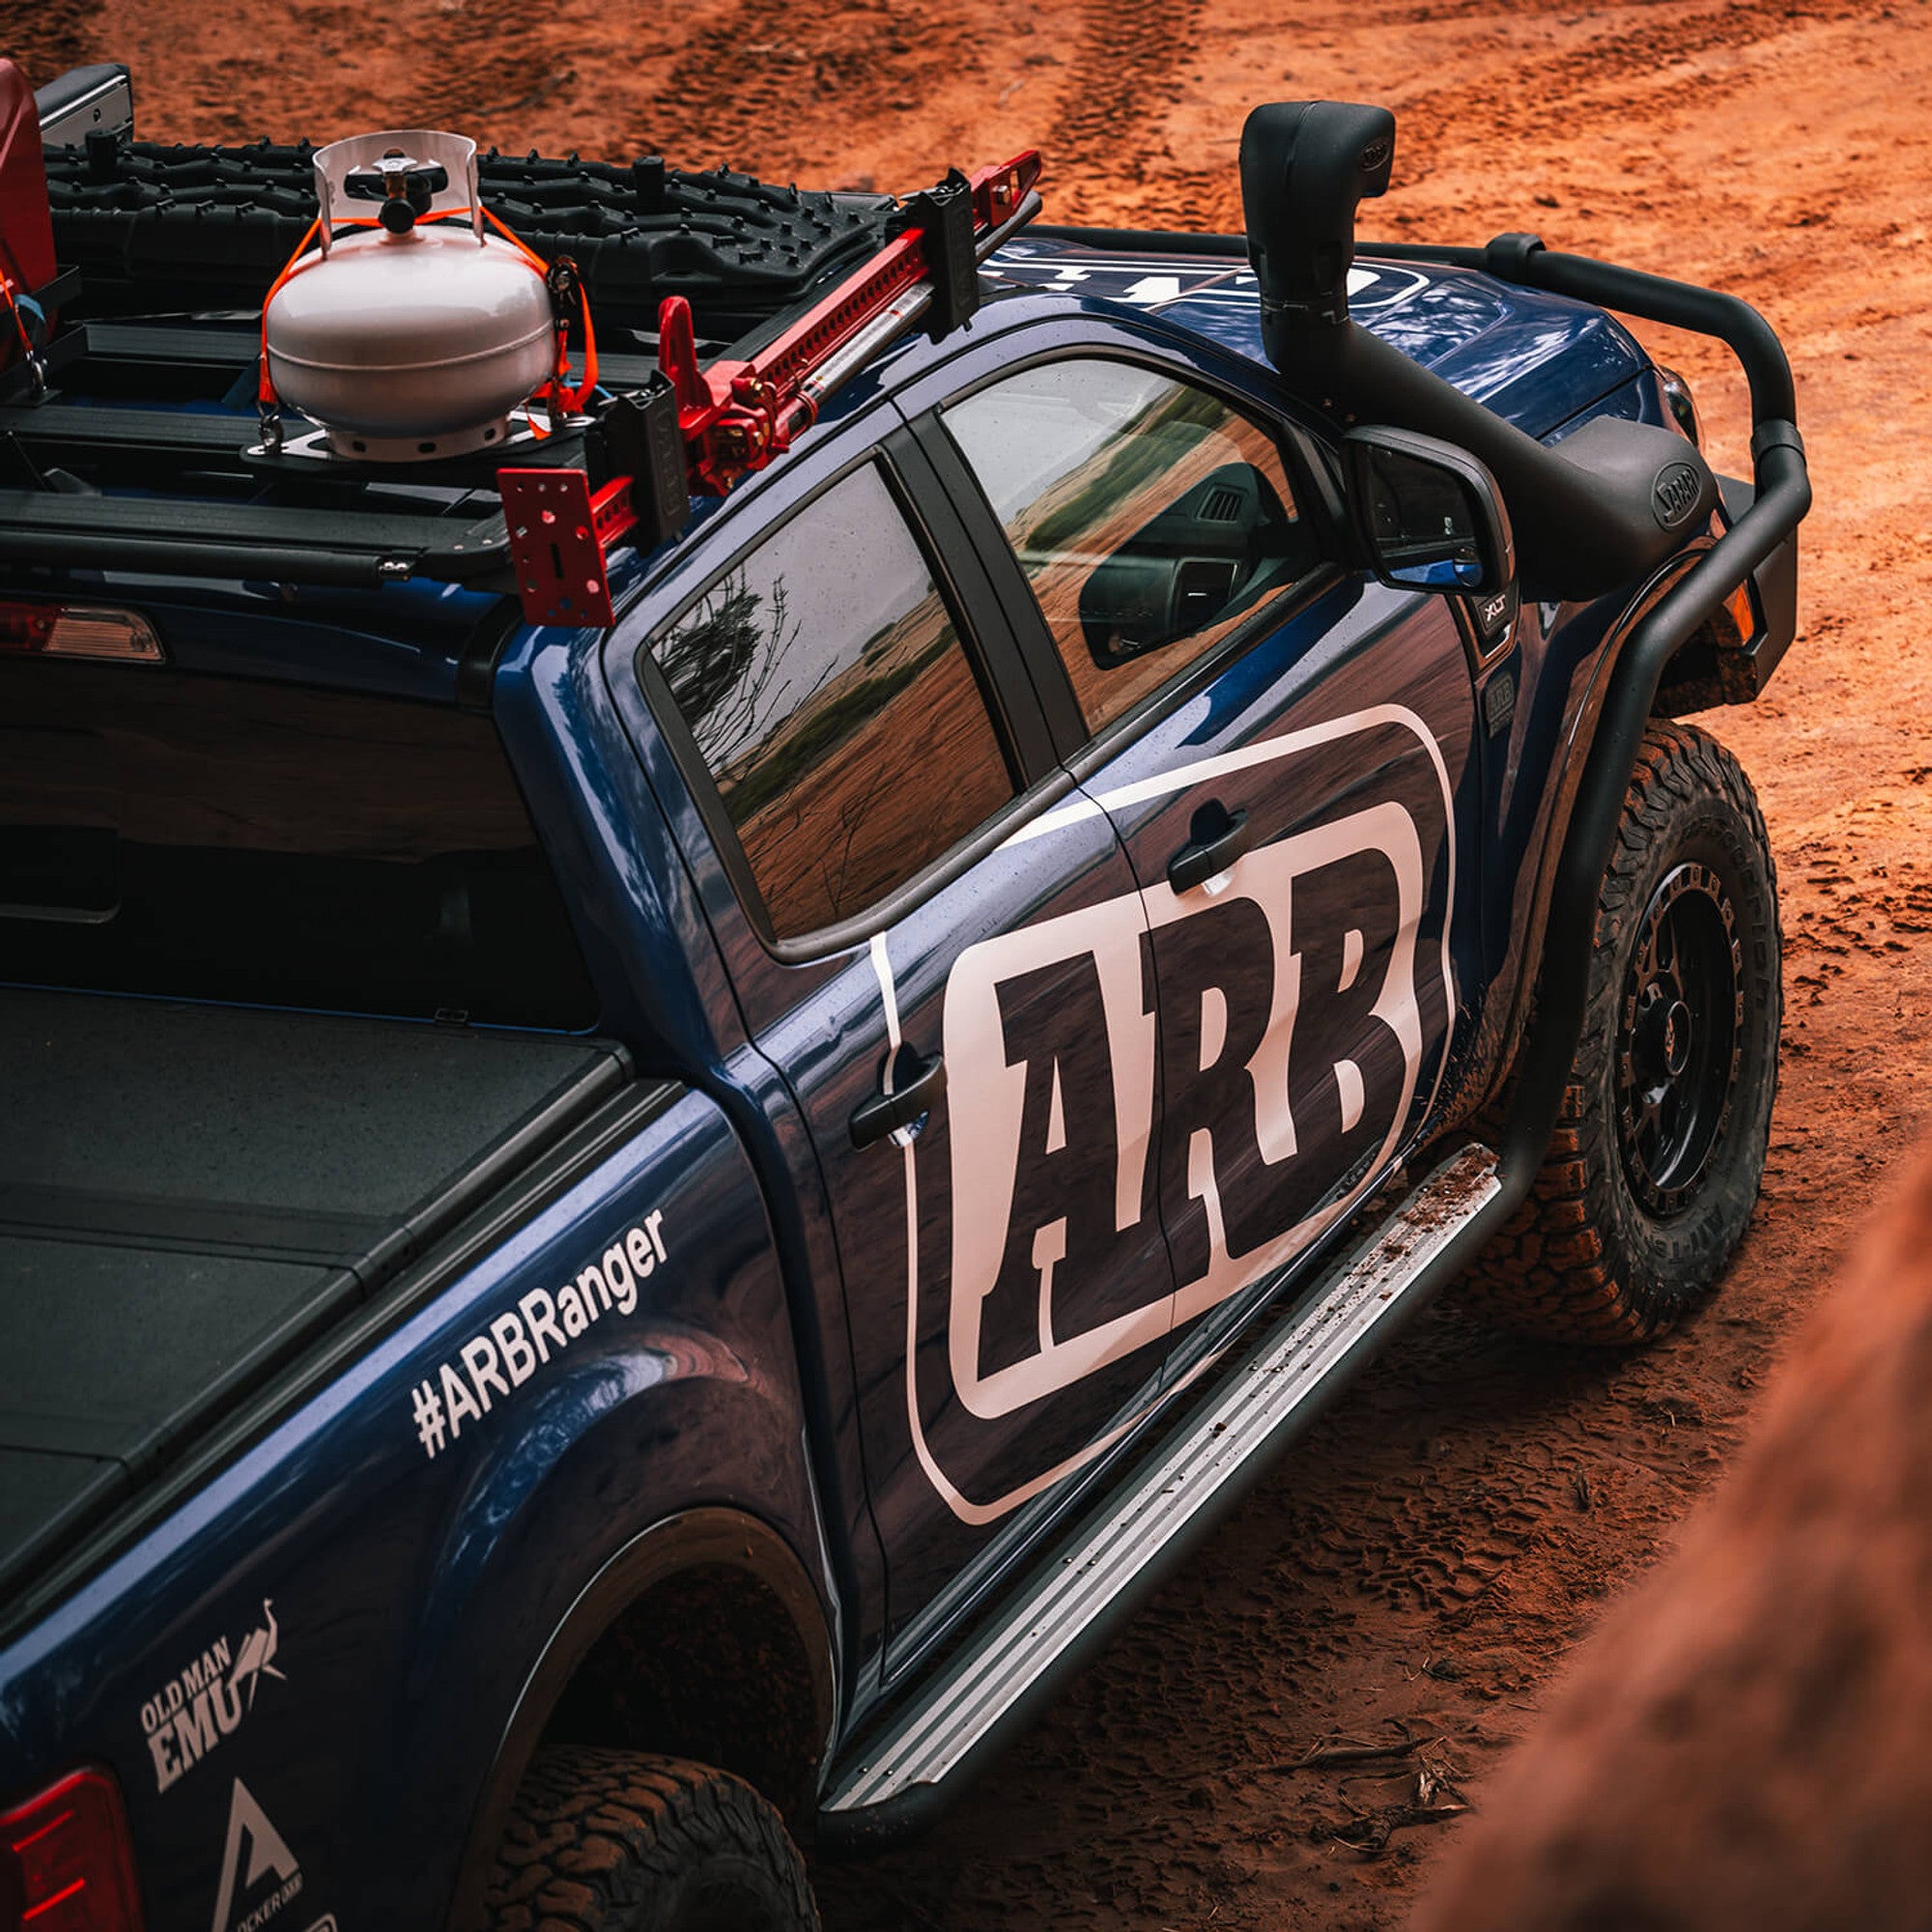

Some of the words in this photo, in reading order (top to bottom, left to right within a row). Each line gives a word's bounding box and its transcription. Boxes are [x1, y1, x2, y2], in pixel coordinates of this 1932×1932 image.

[1656, 467, 1700, 524] SAFARI
[1484, 593, 1506, 622] XLT
[976, 846, 1407, 1382] ARB
[412, 1208, 668, 1460] #ARBRanger
[141, 1679, 183, 1734] OLD
[181, 1634, 232, 1700] MAN
[148, 1676, 242, 1794] EMU
